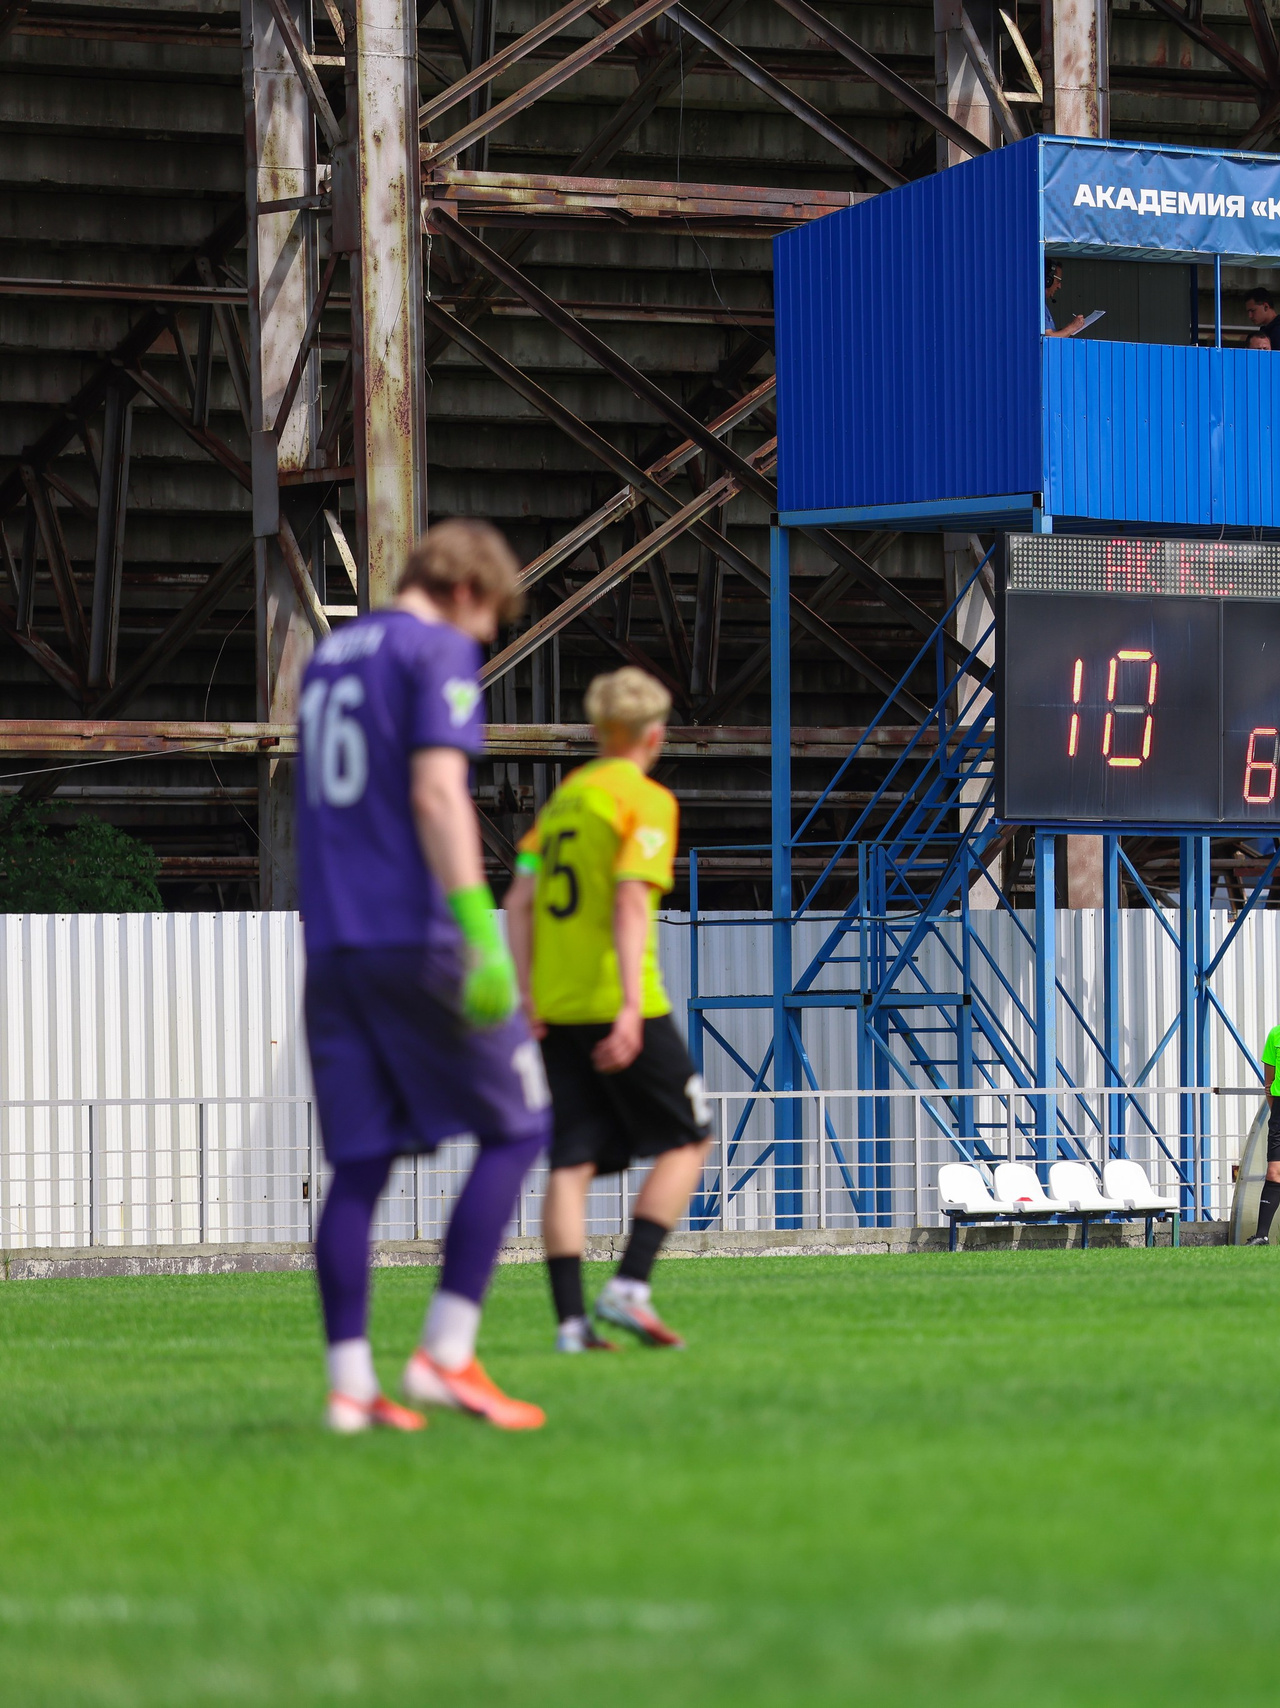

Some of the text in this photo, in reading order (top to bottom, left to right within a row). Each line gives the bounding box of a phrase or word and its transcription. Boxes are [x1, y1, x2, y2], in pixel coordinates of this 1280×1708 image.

[1073, 183, 1245, 218] АКАДЕМИЯ
[300, 675, 370, 808] 16
[1068, 649, 1158, 767] 10
